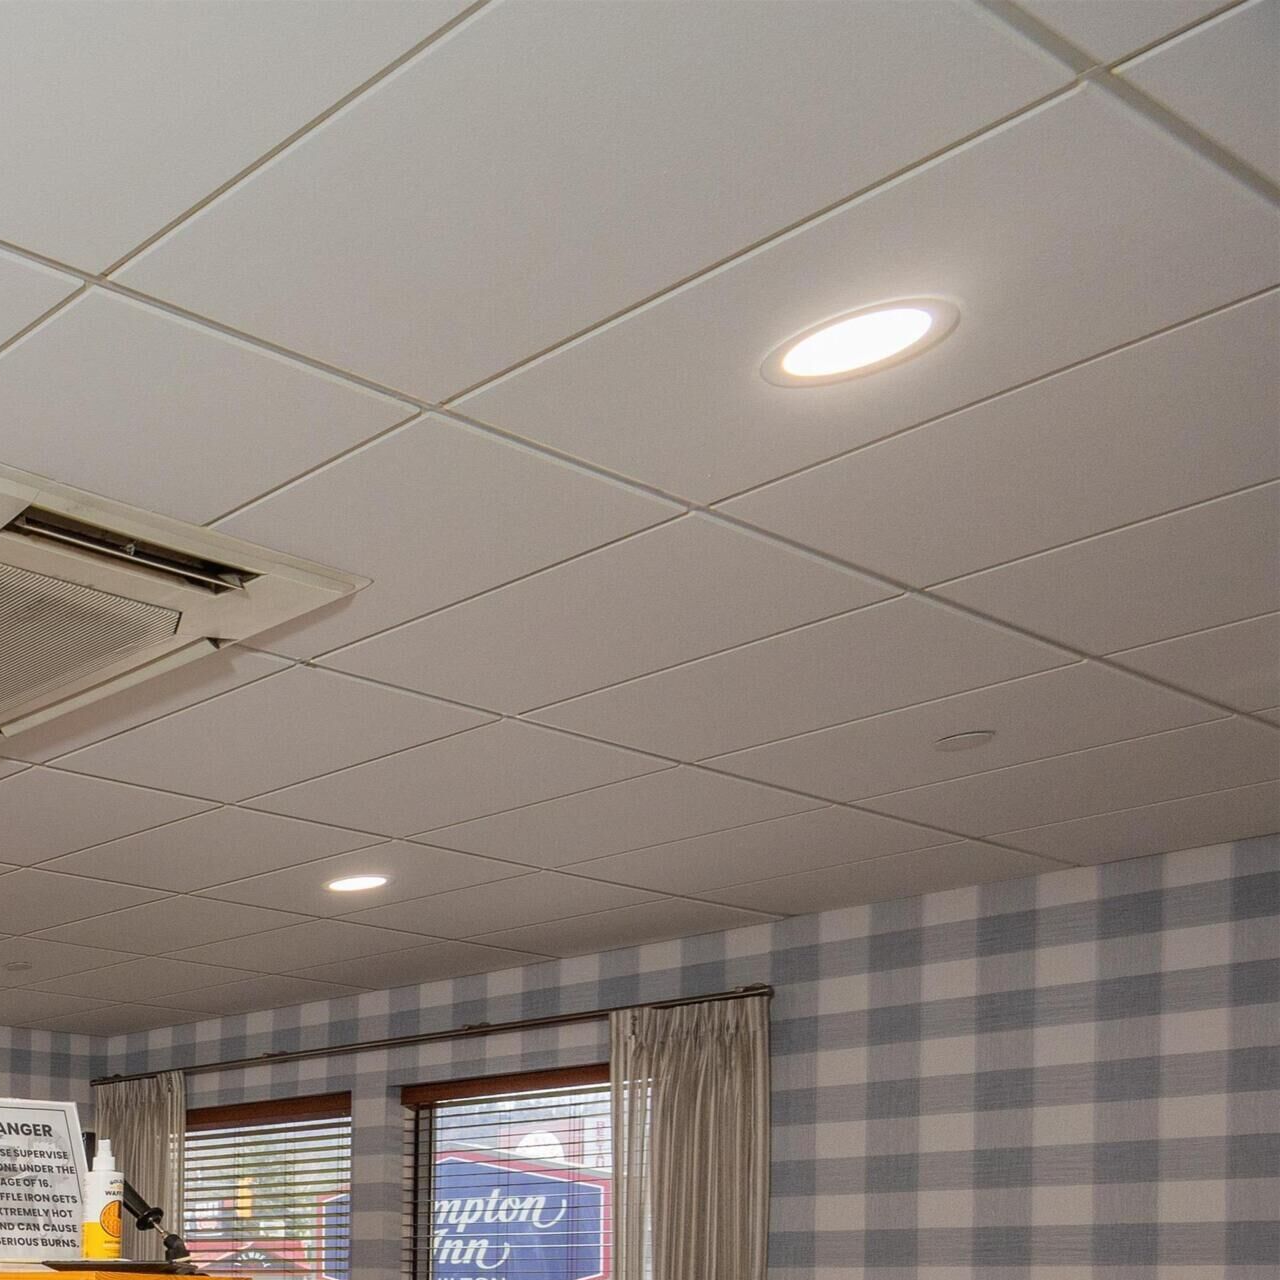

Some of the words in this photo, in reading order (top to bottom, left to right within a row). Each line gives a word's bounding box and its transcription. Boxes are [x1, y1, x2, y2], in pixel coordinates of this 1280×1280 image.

[13, 1149, 68, 1160] SUPERVISE
[19, 1163, 54, 1174] UNDER
[55, 1165, 76, 1174] THE
[0, 1177, 21, 1187] AGE
[22, 1178, 37, 1188] OF
[38, 1179, 53, 1188] 16.
[24, 1193, 50, 1203] IRON
[51, 1194, 78, 1204] GETS
[51, 1209, 73, 1218] HOT
[434, 1188, 567, 1233] mpton
[17, 1222, 41, 1232] CAN
[42, 1223, 79, 1233] CAUSE
[41, 1238, 80, 1248] BURNS.
